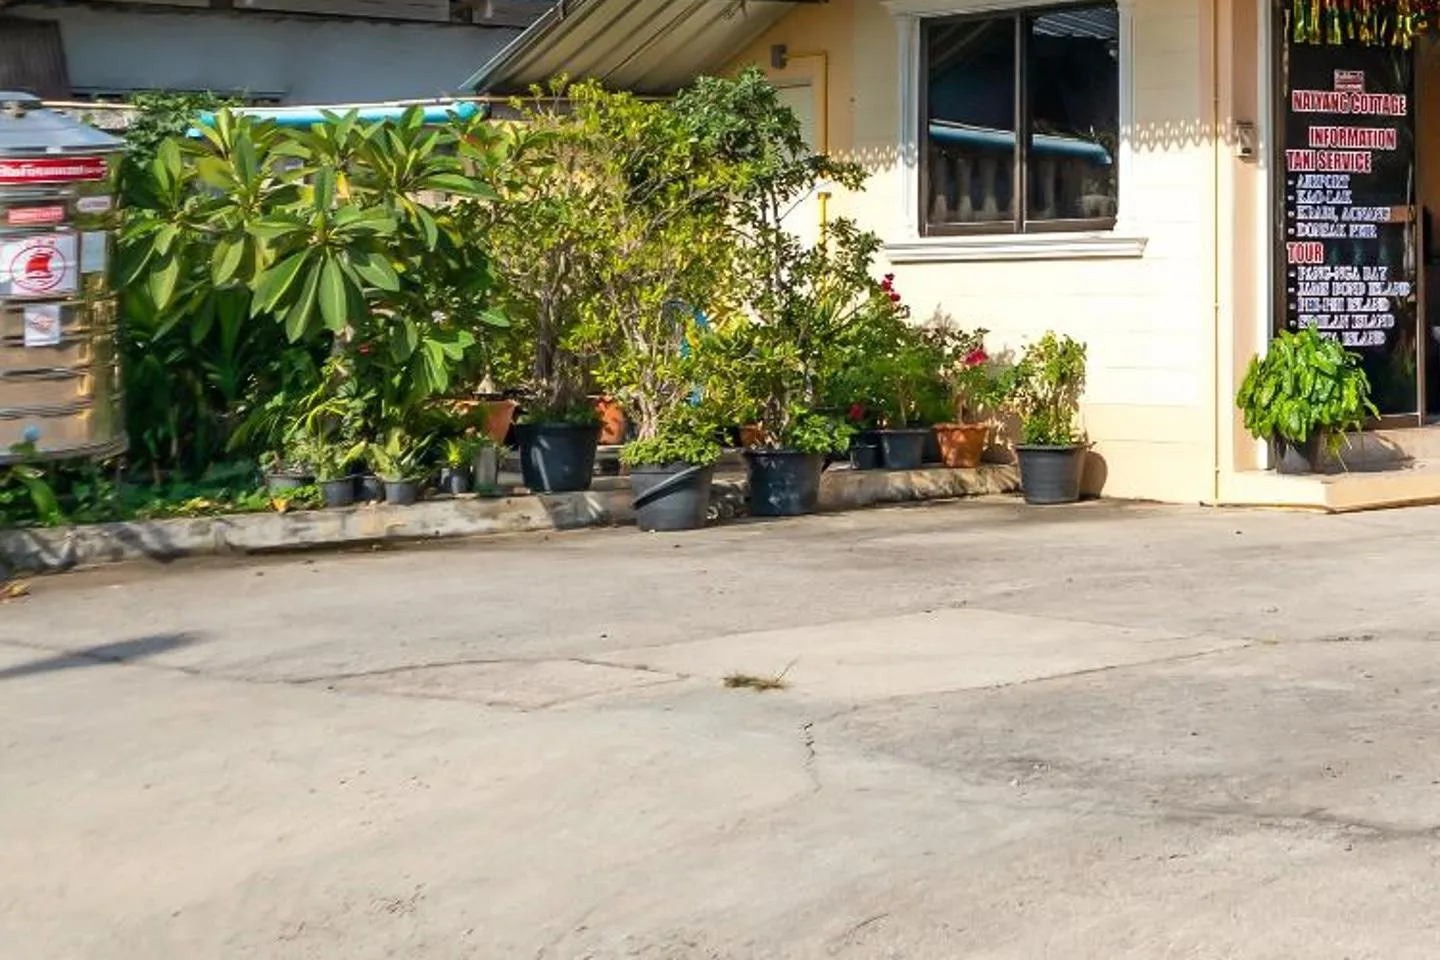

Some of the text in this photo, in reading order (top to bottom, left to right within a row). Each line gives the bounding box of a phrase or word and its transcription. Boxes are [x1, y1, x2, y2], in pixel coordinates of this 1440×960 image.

[1292, 90, 1407, 116] NAIYANG COTTAGE
[1308, 126, 1397, 150] INFORMATION
[1317, 150, 1372, 173] SERVICE
[1286, 242, 1324, 264] TOUR
[1347, 297, 1390, 312] ISLAND
[1351, 314, 1394, 328] ISLAND
